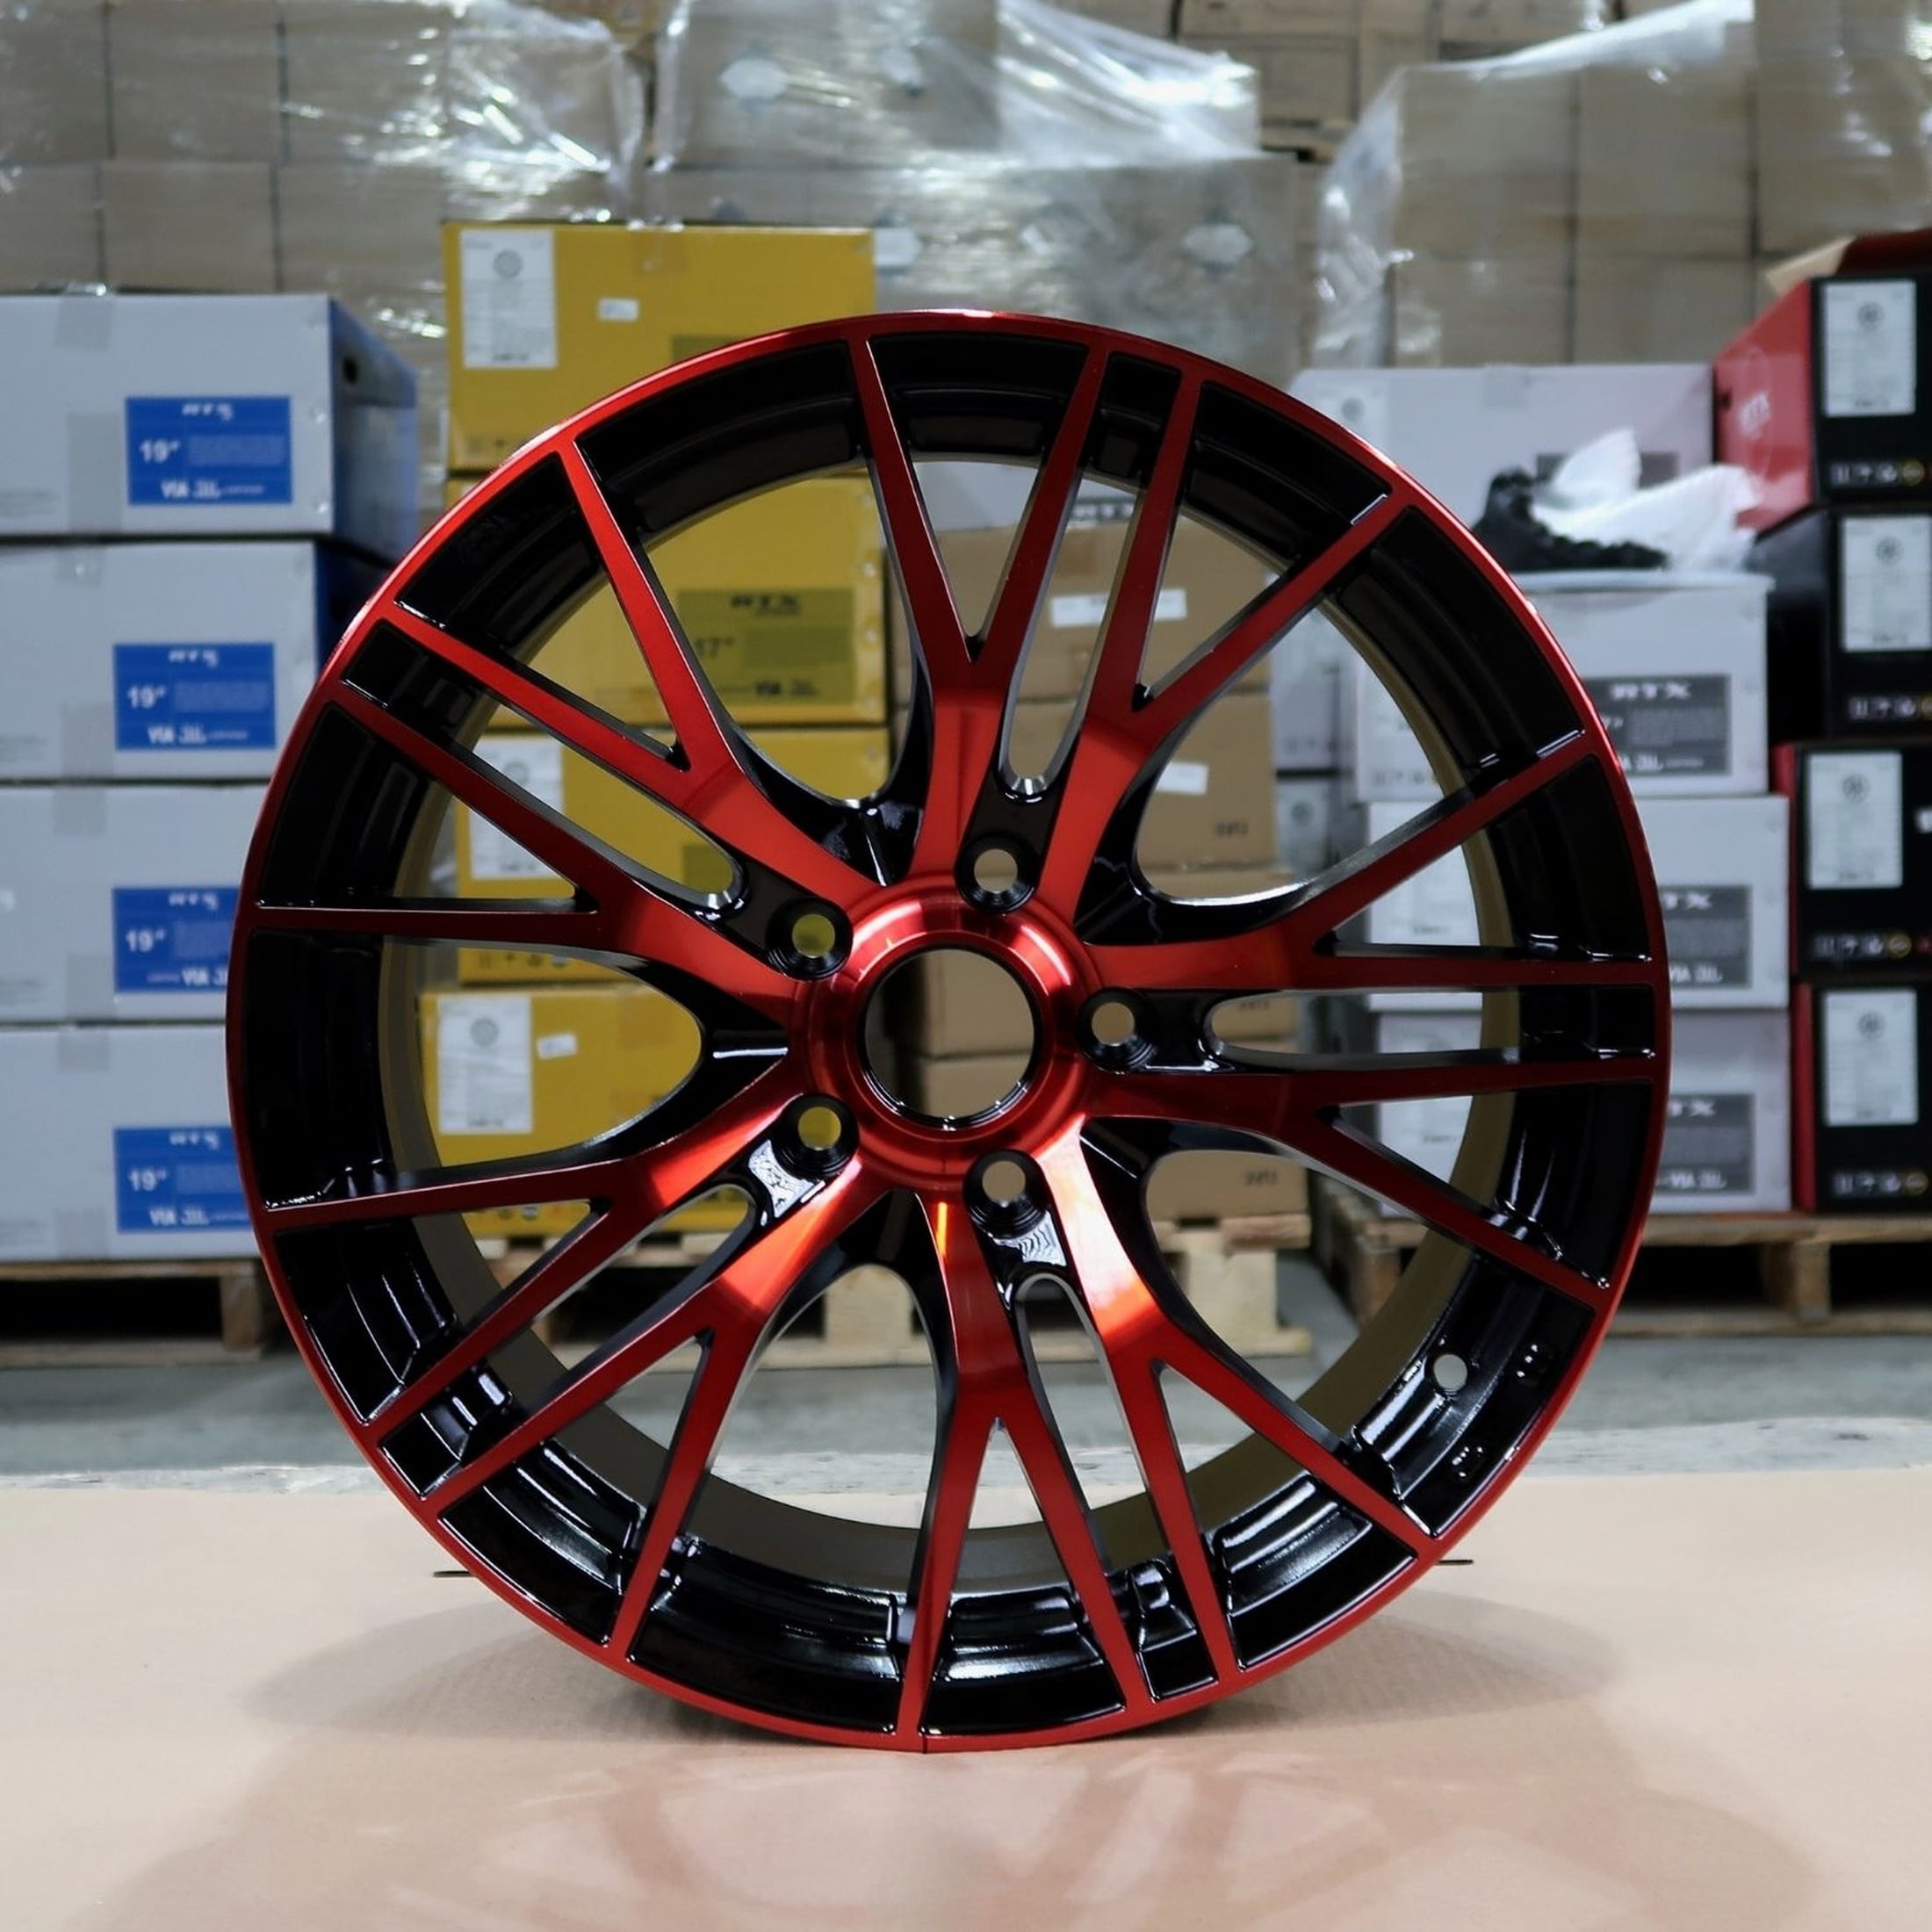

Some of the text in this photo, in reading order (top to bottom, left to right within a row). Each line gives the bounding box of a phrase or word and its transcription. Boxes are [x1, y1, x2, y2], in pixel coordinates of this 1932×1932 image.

[140, 440, 181, 463] 19"
[126, 686, 167, 709] 19"
[1610, 681, 1693, 699] RTX
[1662, 892, 1712, 910] TX
[126, 928, 166, 952] 19"
[129, 1169, 168, 1192] 19"
